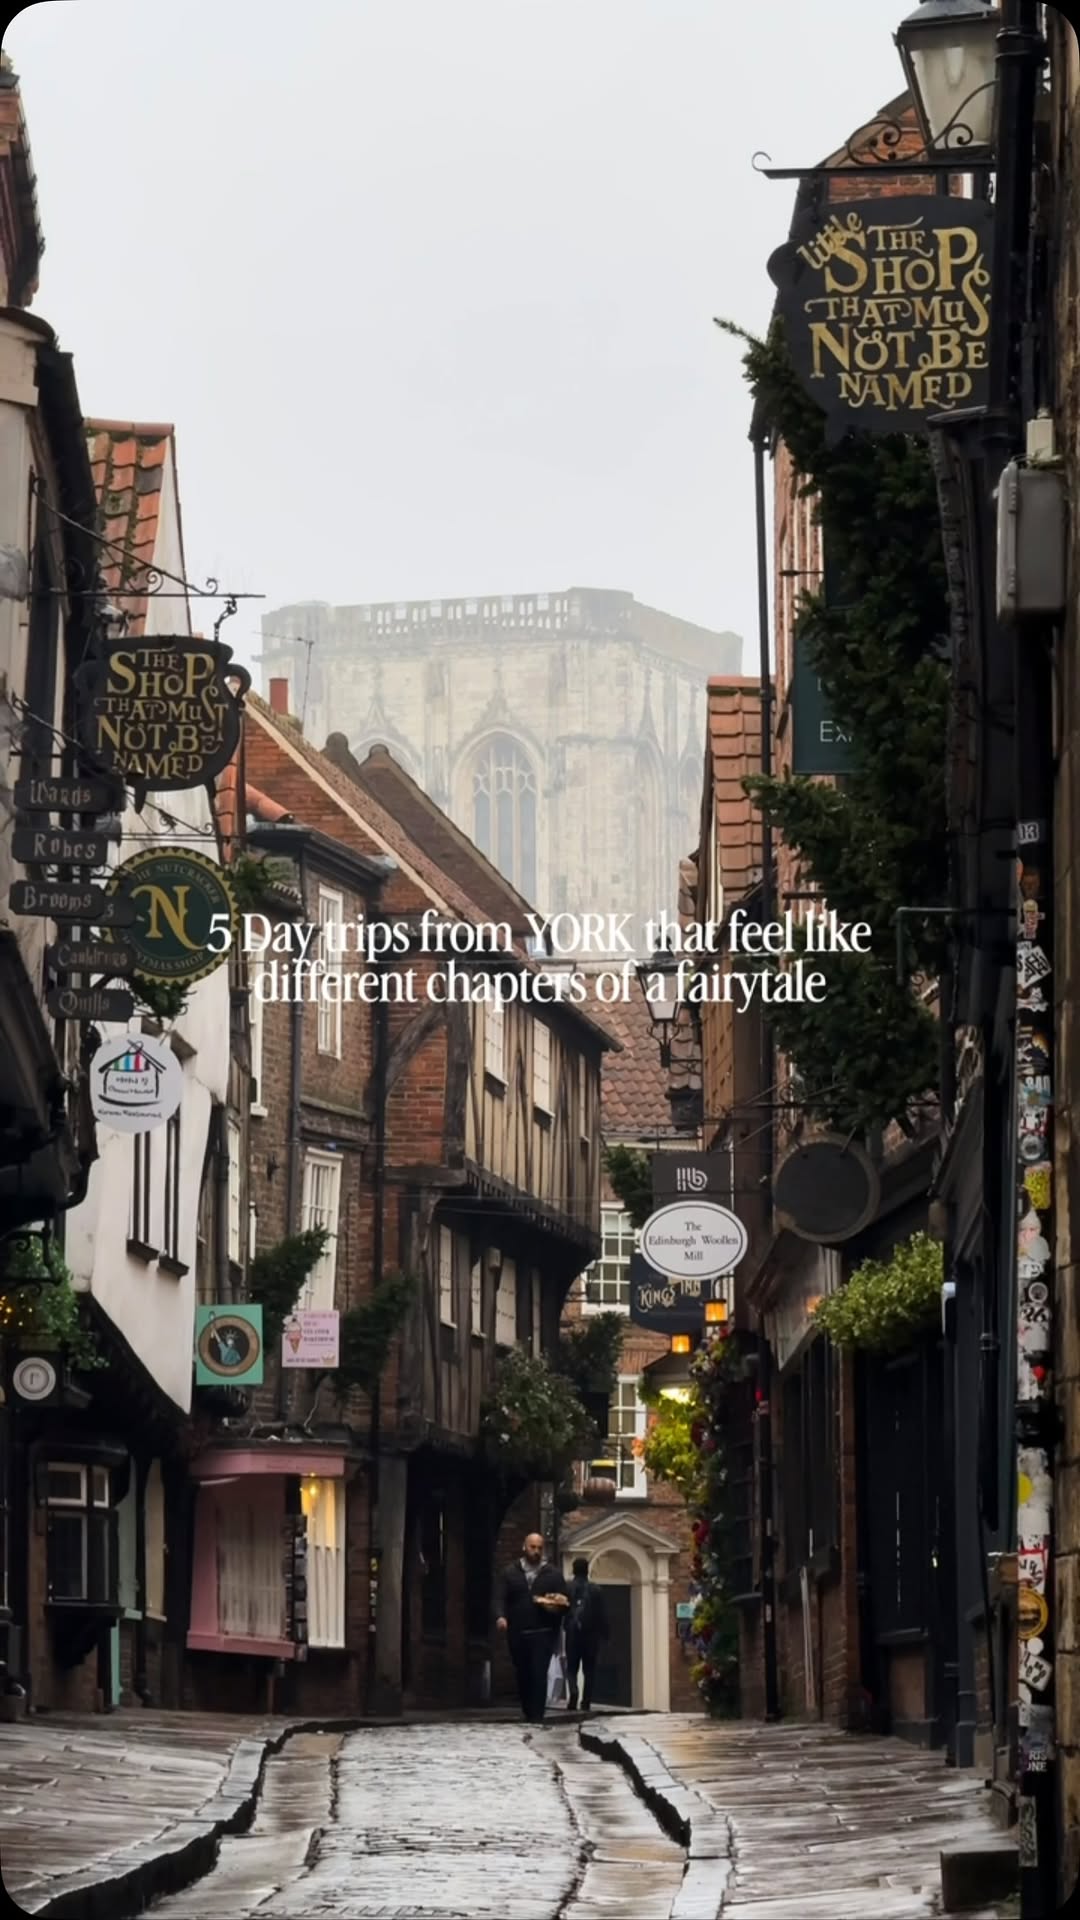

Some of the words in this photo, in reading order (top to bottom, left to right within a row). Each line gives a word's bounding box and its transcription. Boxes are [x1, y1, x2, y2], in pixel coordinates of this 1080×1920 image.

[796, 211, 863, 271] little
[867, 216, 934, 258] THE
[824, 226, 979, 295] SHOP
[804, 296, 912, 329] THAT
[912, 254, 992, 337] MUS
[808, 322, 916, 378] NOT
[918, 329, 990, 375] BE
[837, 370, 973, 411] NAMED
[106, 651, 216, 698] SHOP
[137, 646, 185, 672] THE
[94, 697, 167, 721] THAT
[168, 674, 230, 742] MUST
[96, 715, 167, 755] NOT
[168, 724, 221, 754] BE
[112, 751, 204, 780] NAMED
[33, 832, 97, 860] Robes
[22, 886, 93, 912] Brooms
[129, 884, 208, 951] N
[649, 1235, 697, 1247] Edinburgh
[702, 1235, 739, 1246] Woollen
[685, 1221, 702, 1232] The
[683, 1251, 704, 1261] Mill
